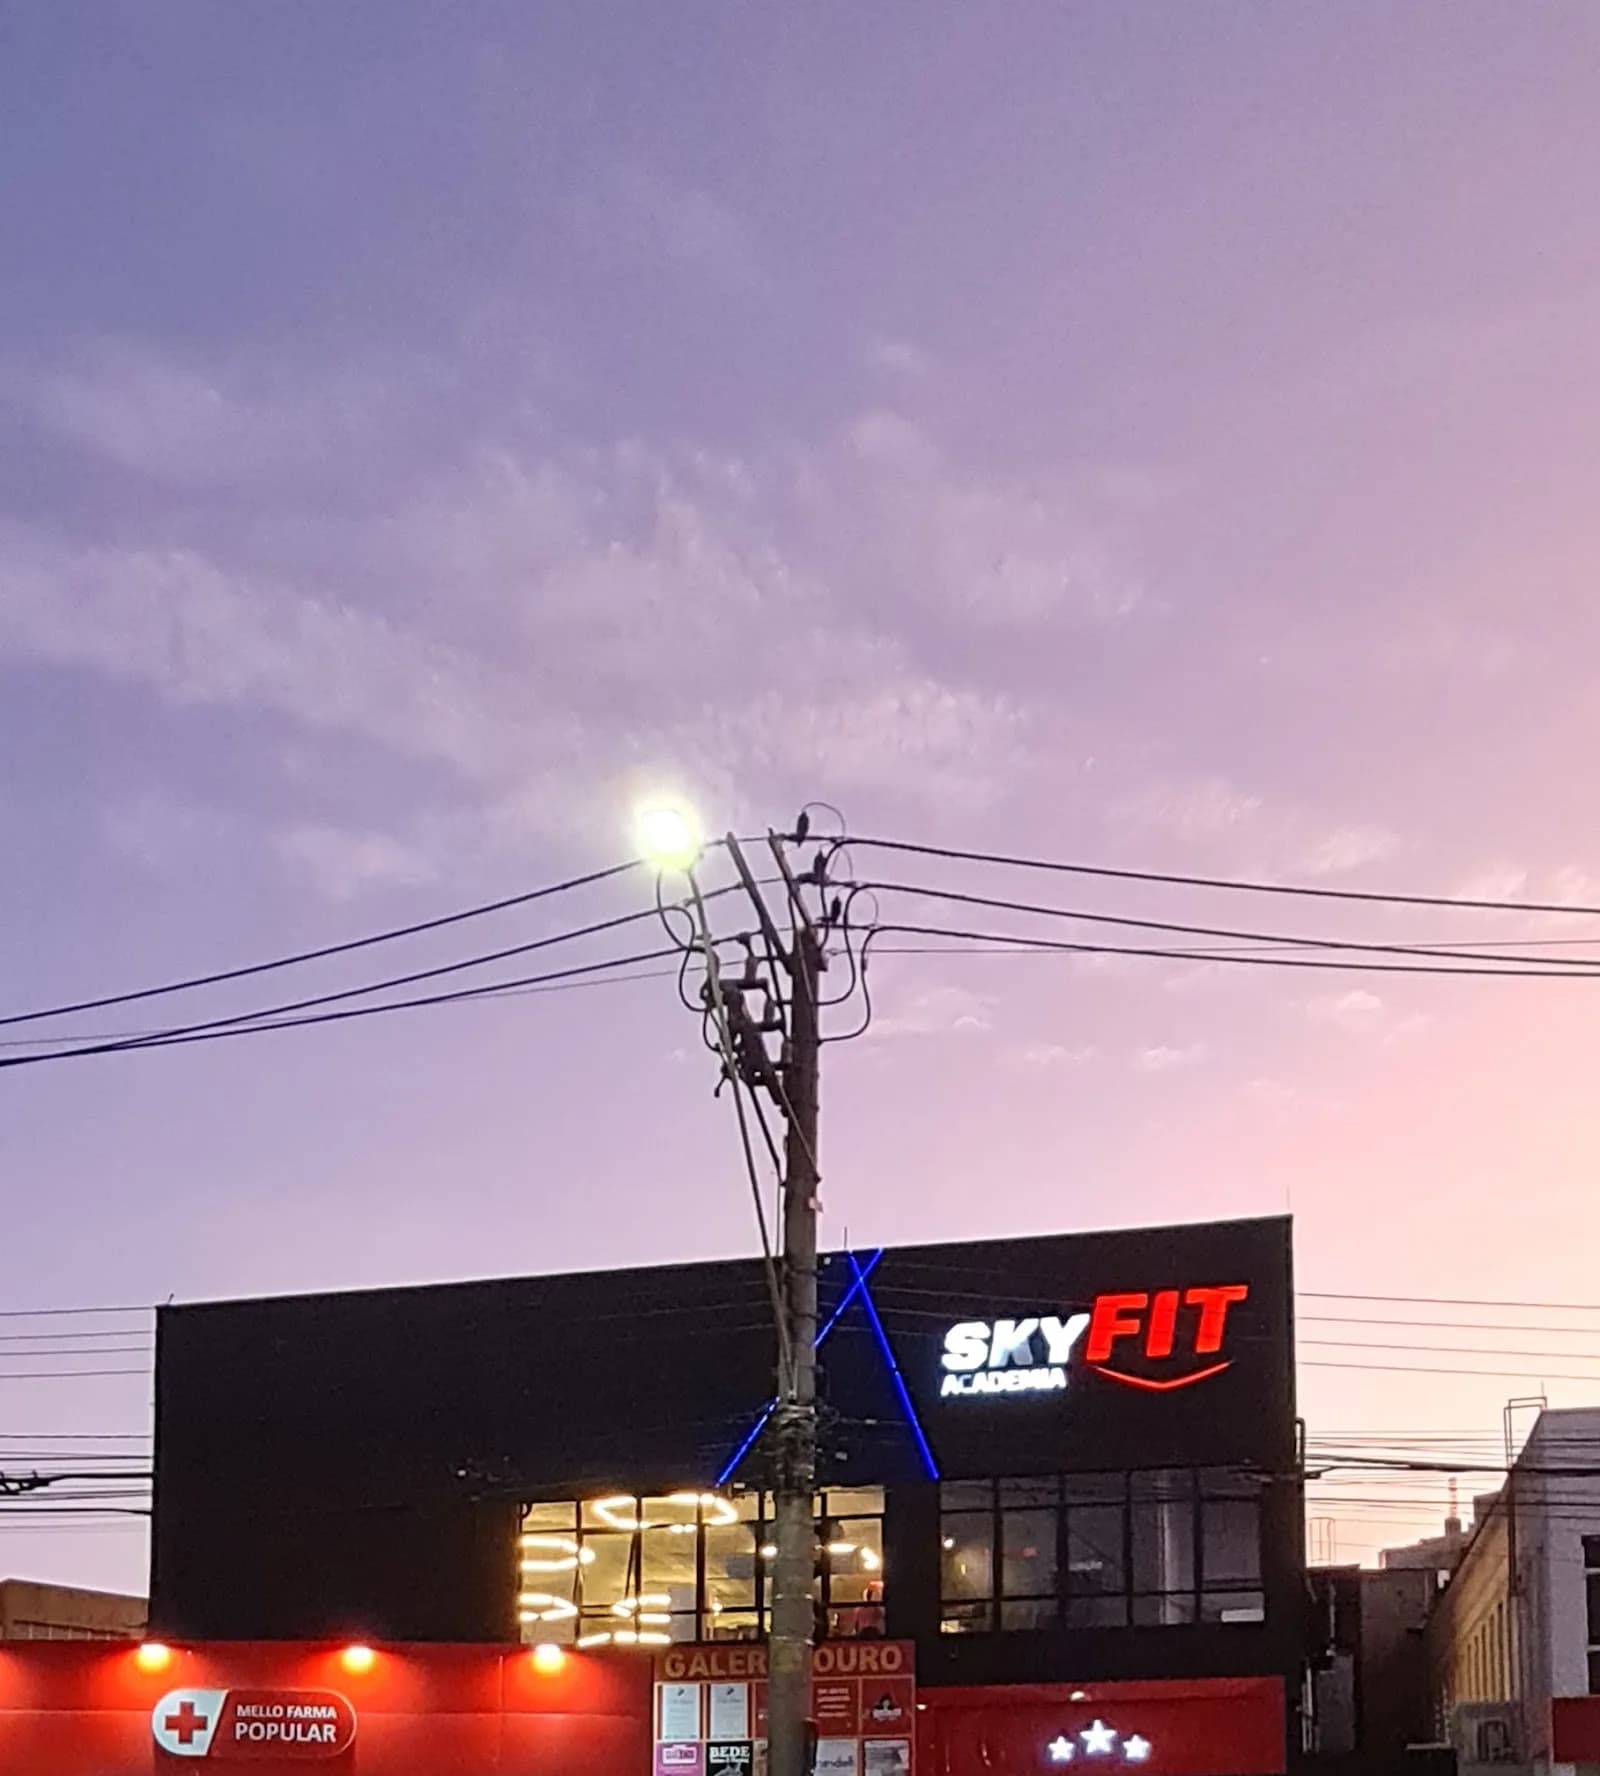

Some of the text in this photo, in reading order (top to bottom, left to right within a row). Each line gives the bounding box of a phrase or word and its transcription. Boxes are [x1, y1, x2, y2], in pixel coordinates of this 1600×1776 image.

[941, 1367, 1067, 1397] ACADEMIA
[664, 1646, 902, 1678] GALER OURO
[236, 1704, 337, 1719] MELLO FARMA
[234, 1721, 337, 1743] POPULAR
